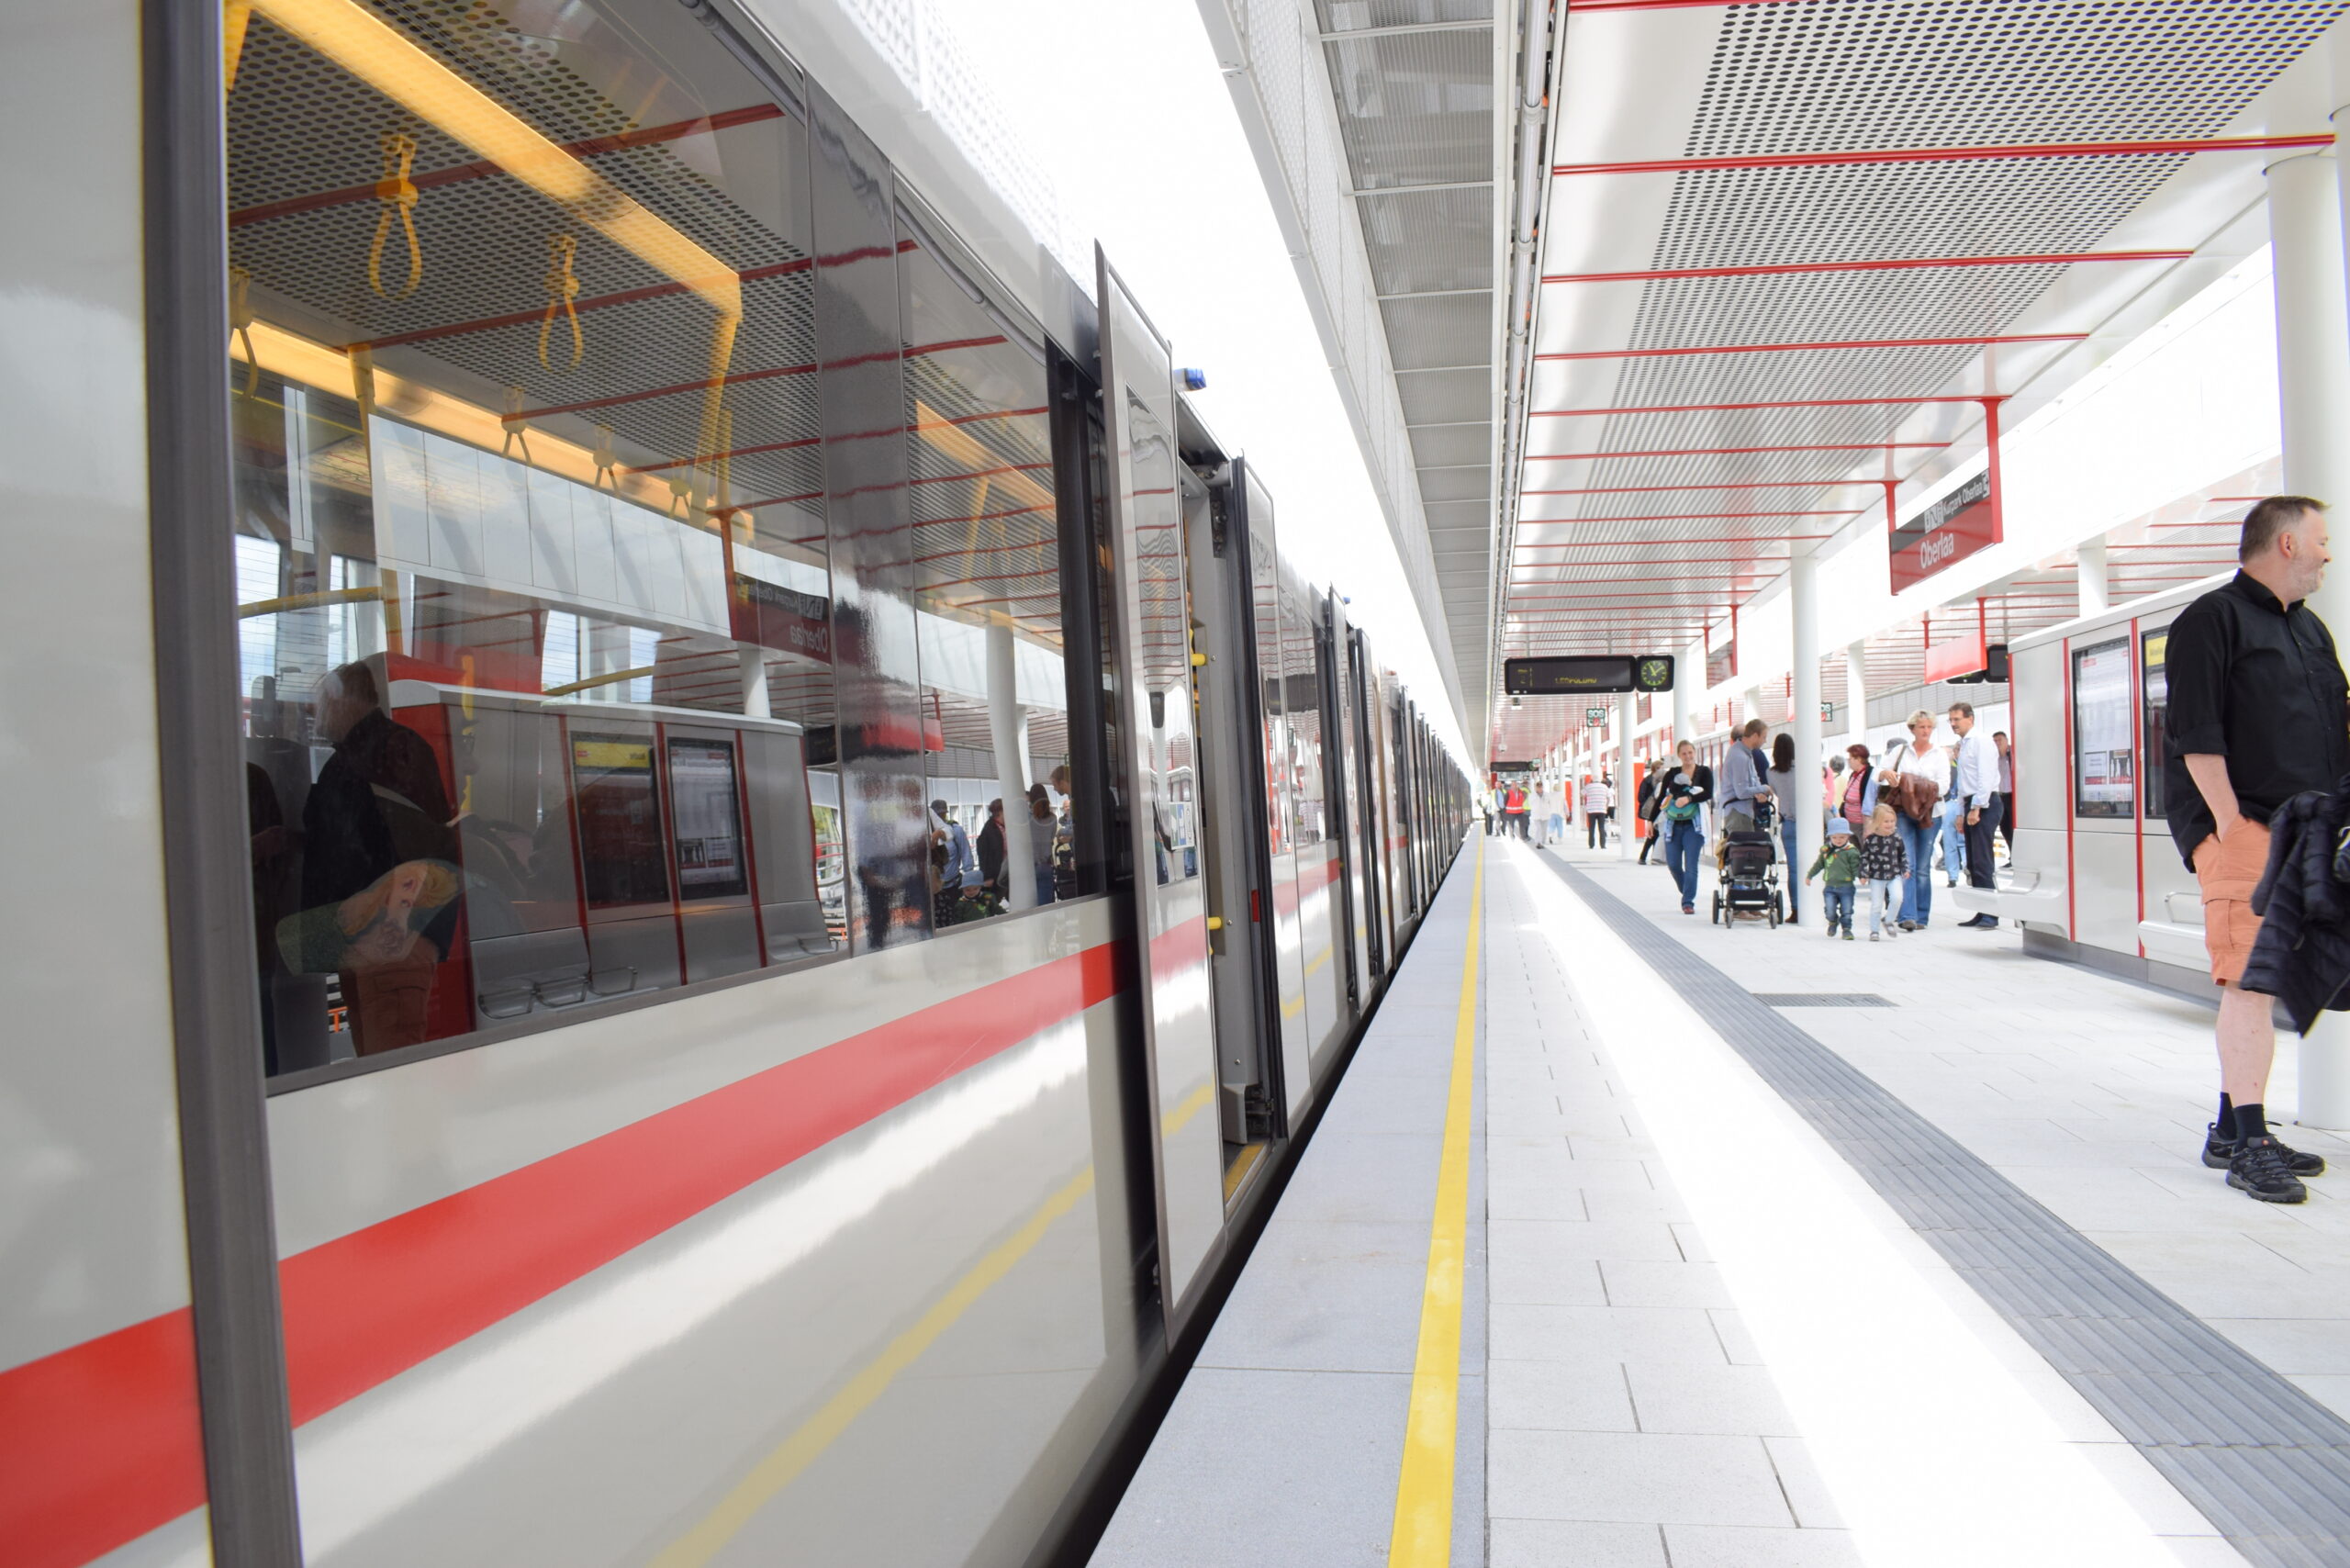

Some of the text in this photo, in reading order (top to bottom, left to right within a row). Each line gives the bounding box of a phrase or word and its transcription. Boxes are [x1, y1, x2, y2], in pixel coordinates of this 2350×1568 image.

[1943, 482, 1984, 515] Kurpark Oberlaa
[1920, 532, 1954, 569] Oberlaa
[1587, 710, 1605, 718] SOS
